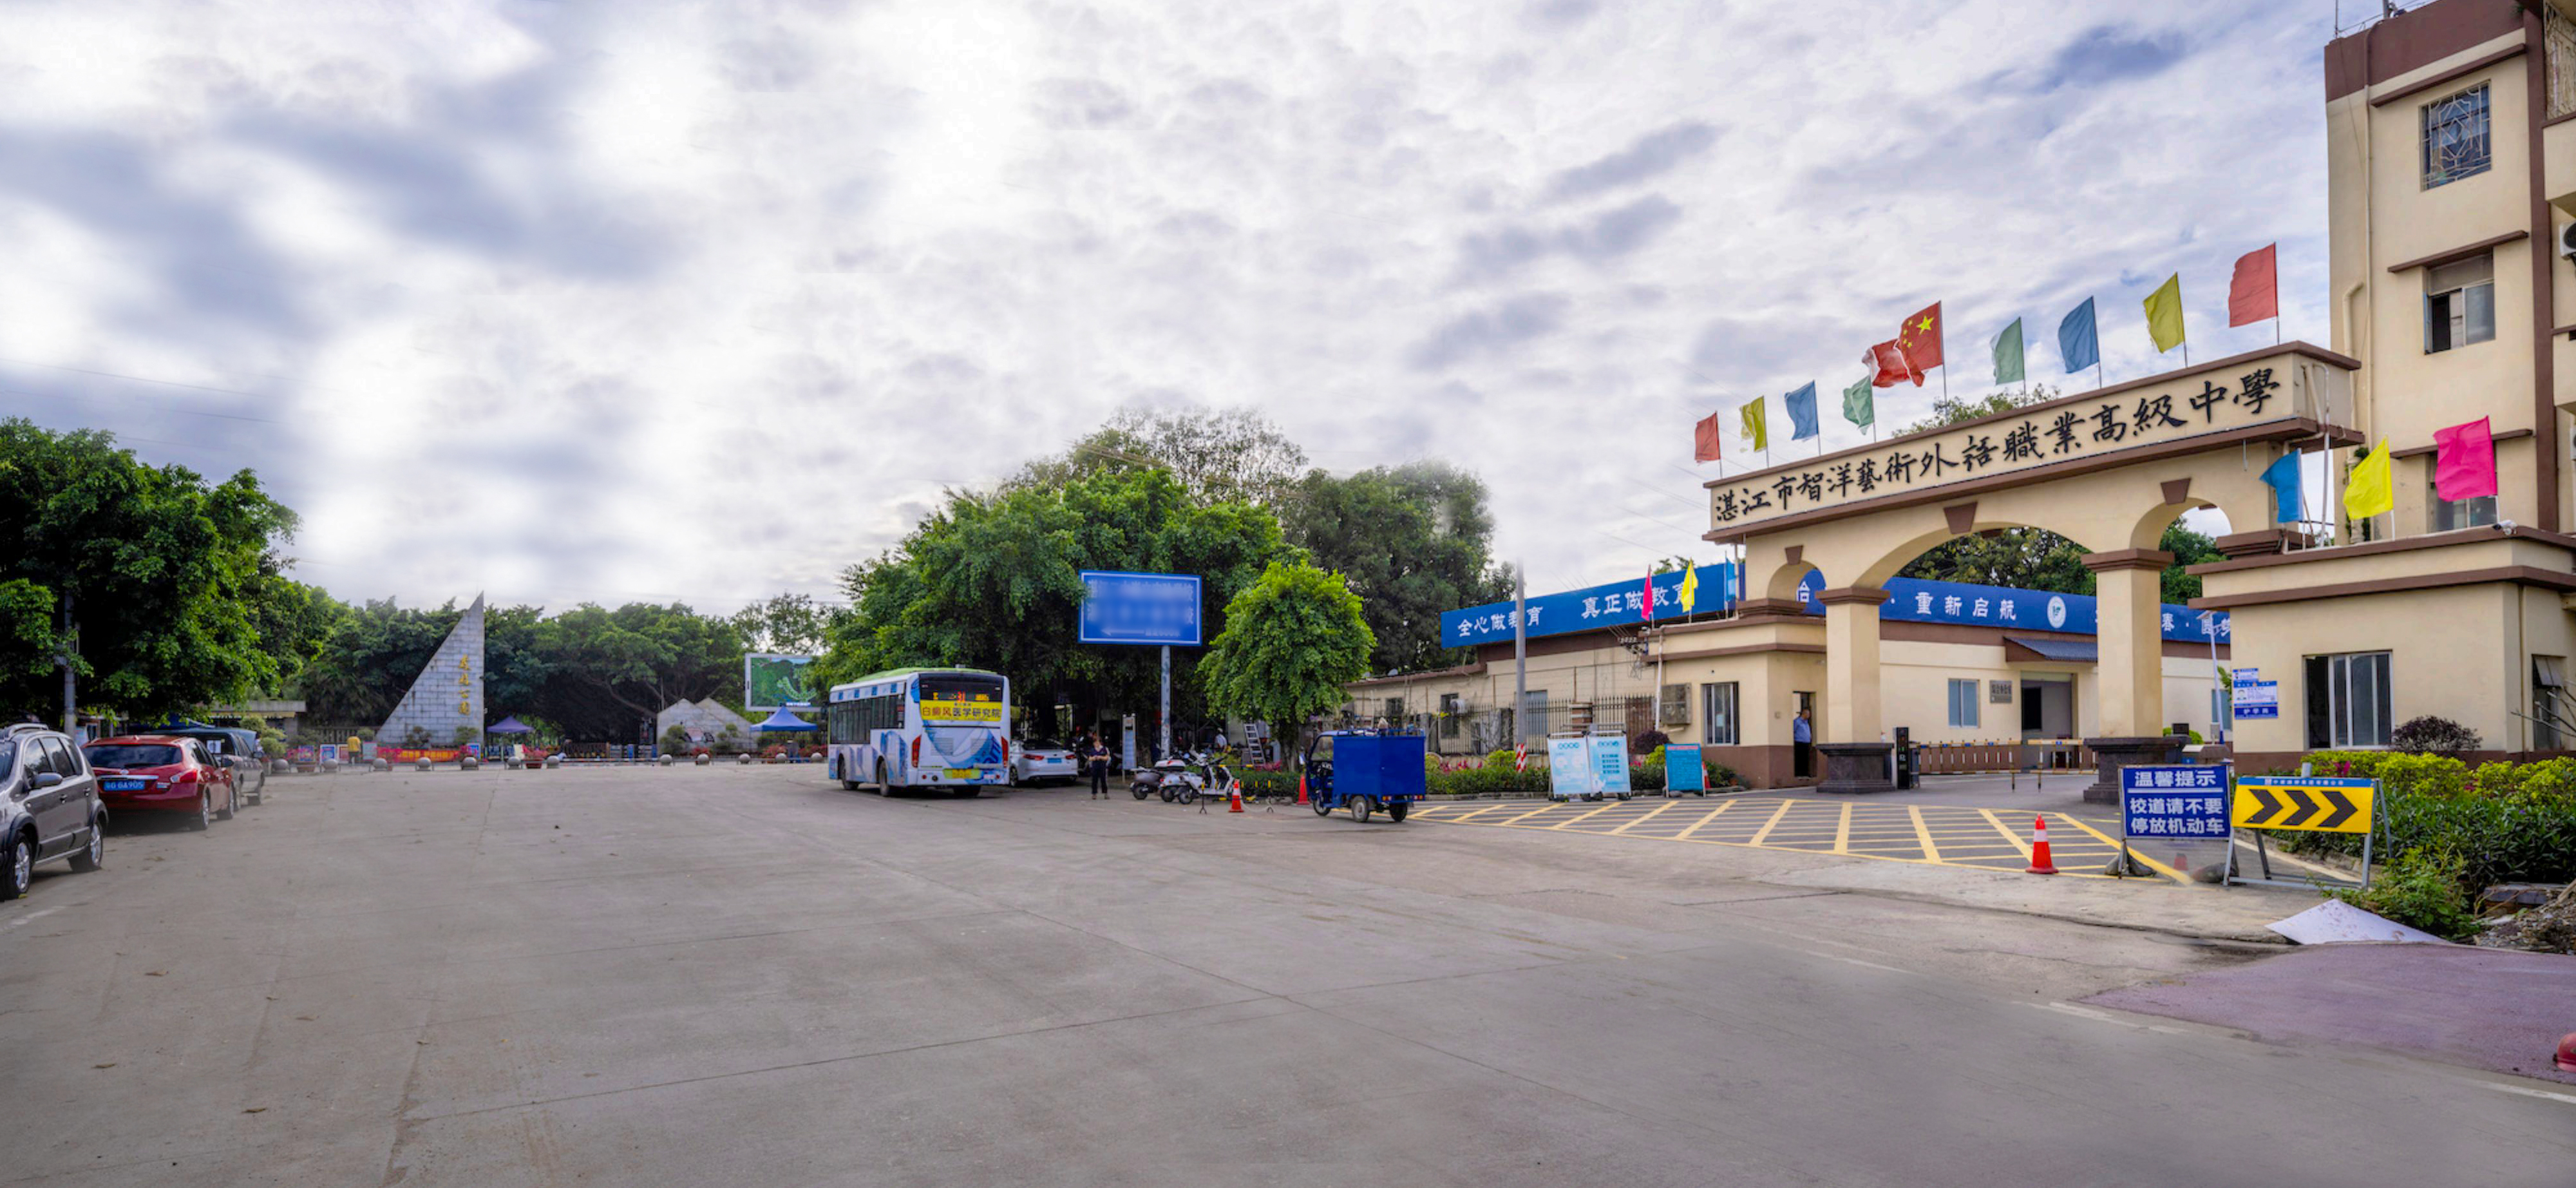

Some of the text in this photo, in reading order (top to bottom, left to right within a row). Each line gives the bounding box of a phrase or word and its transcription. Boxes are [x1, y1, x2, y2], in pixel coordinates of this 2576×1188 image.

[2134, 770, 2217, 787] 温馨提示
[2130, 798, 2223, 814] 校道请不要
[2131, 818, 2225, 834] 停放机动车
